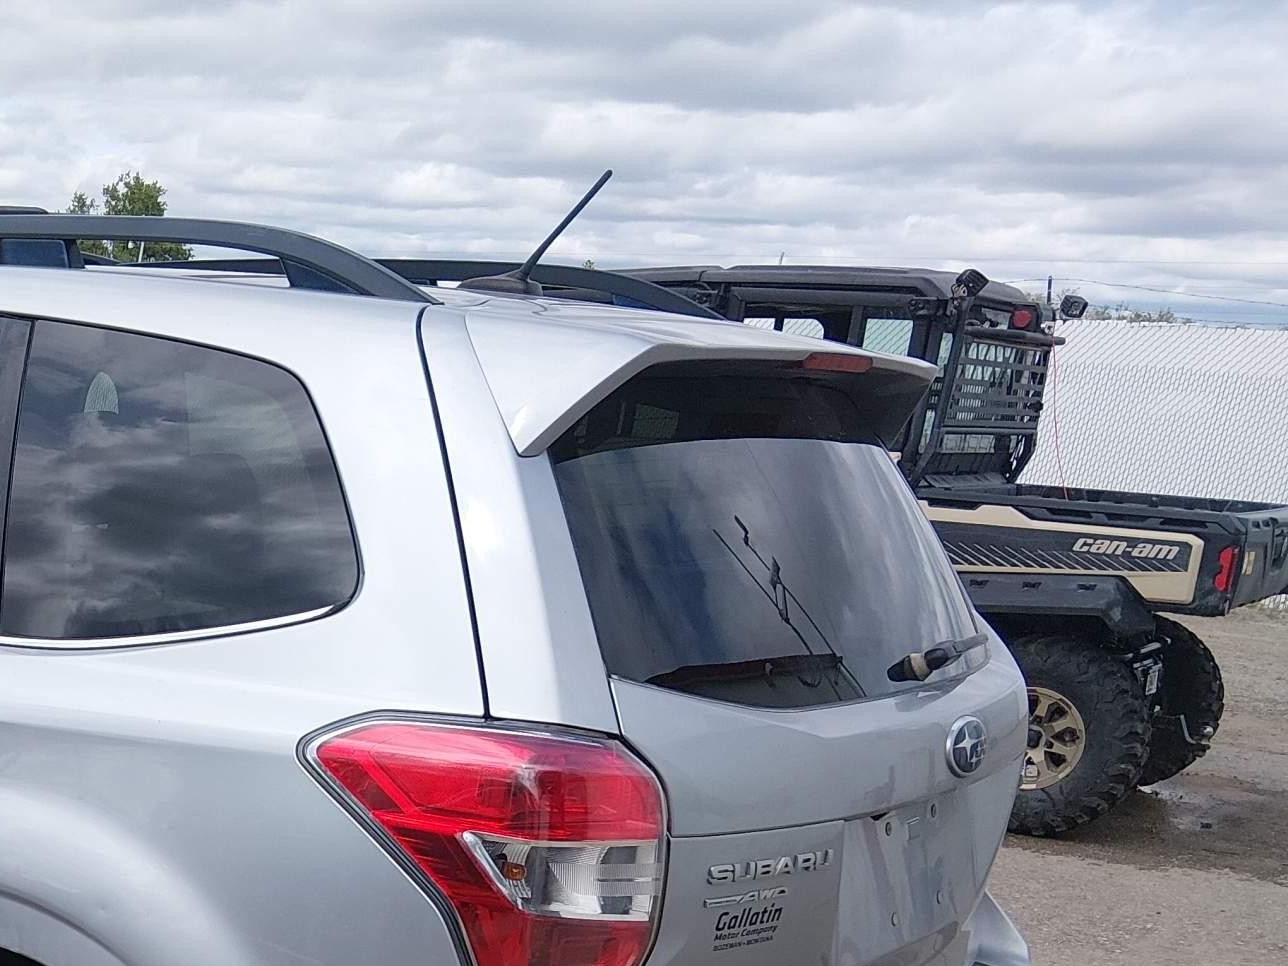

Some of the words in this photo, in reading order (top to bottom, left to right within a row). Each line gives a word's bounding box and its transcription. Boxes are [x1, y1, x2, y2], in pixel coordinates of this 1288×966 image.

[1072, 538, 1180, 560] can-am
[707, 849, 833, 884] SUBARU
[715, 903, 783, 931] Gallatin
[714, 931, 740, 941] Motor
[741, 925, 778, 937] Company
